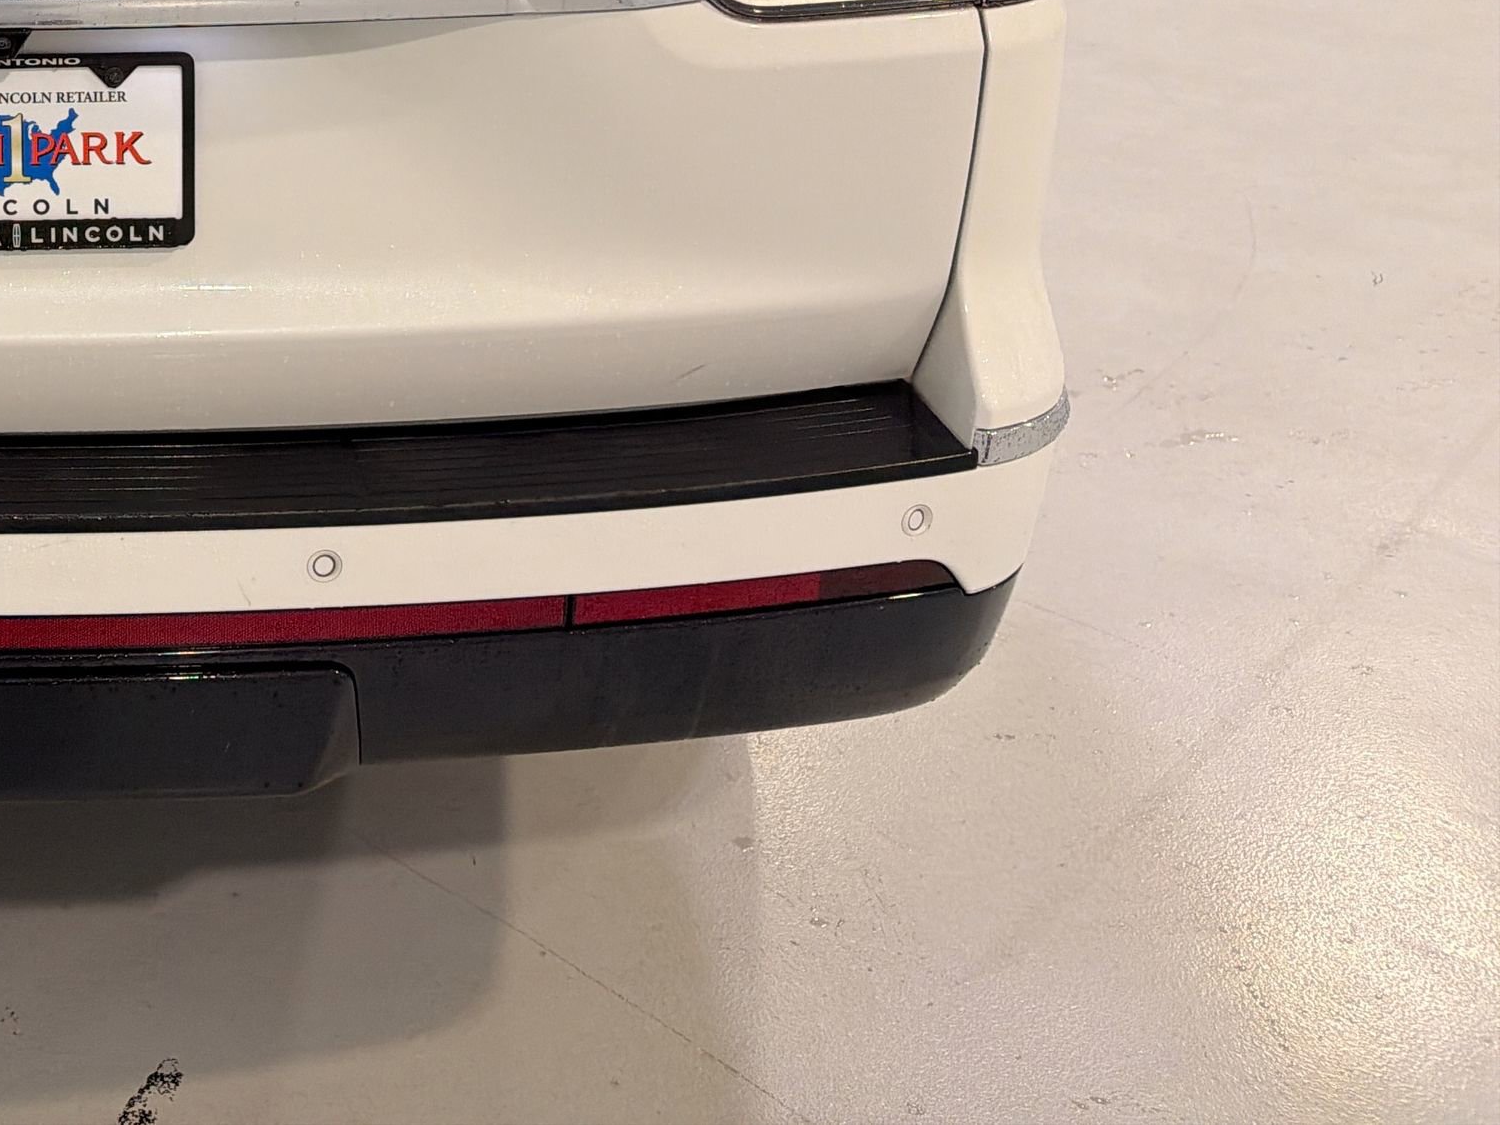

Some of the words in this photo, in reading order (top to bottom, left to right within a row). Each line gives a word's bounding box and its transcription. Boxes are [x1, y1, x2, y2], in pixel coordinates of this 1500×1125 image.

[56, 91, 127, 104] RETAILER
[30, 131, 152, 165] PARK
[31, 225, 164, 243] LINCOLN
